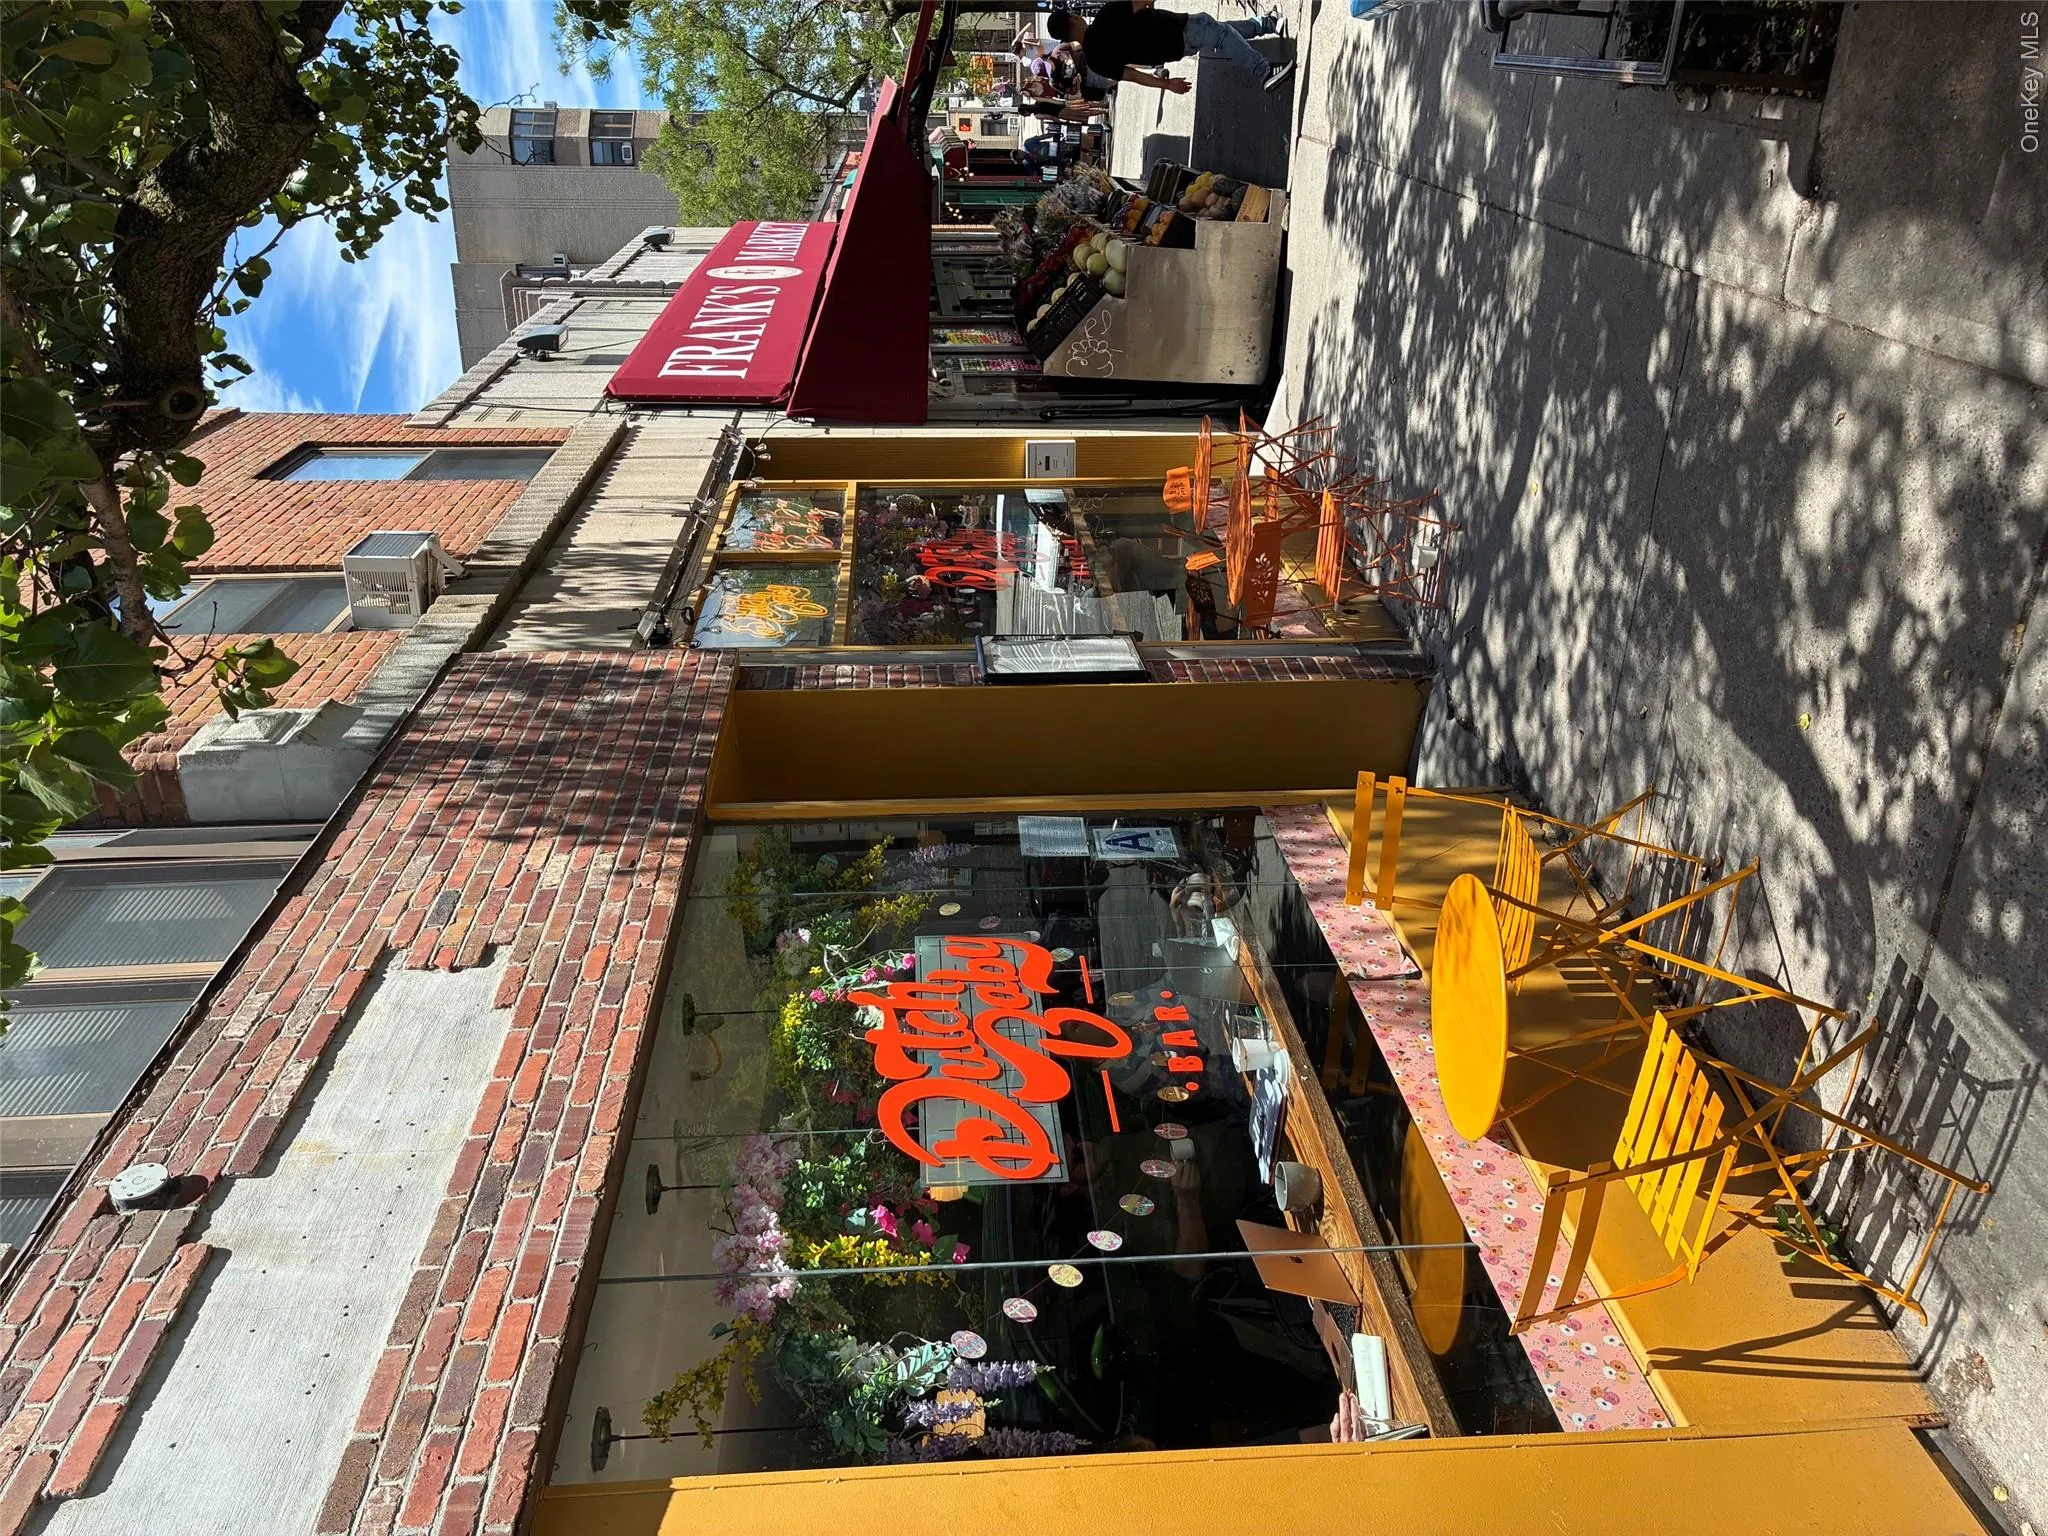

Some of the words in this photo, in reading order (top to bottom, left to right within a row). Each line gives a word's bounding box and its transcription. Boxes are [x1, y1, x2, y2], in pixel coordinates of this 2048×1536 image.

[657, 285, 782, 379] FRANK'S
[733, 221, 811, 262] MARKET
[1105, 832, 1155, 853] A
[847, 981, 1060, 1178] Dutch
[926, 937, 1132, 1102] Baby
[1153, 1005, 1204, 1072] BAR
